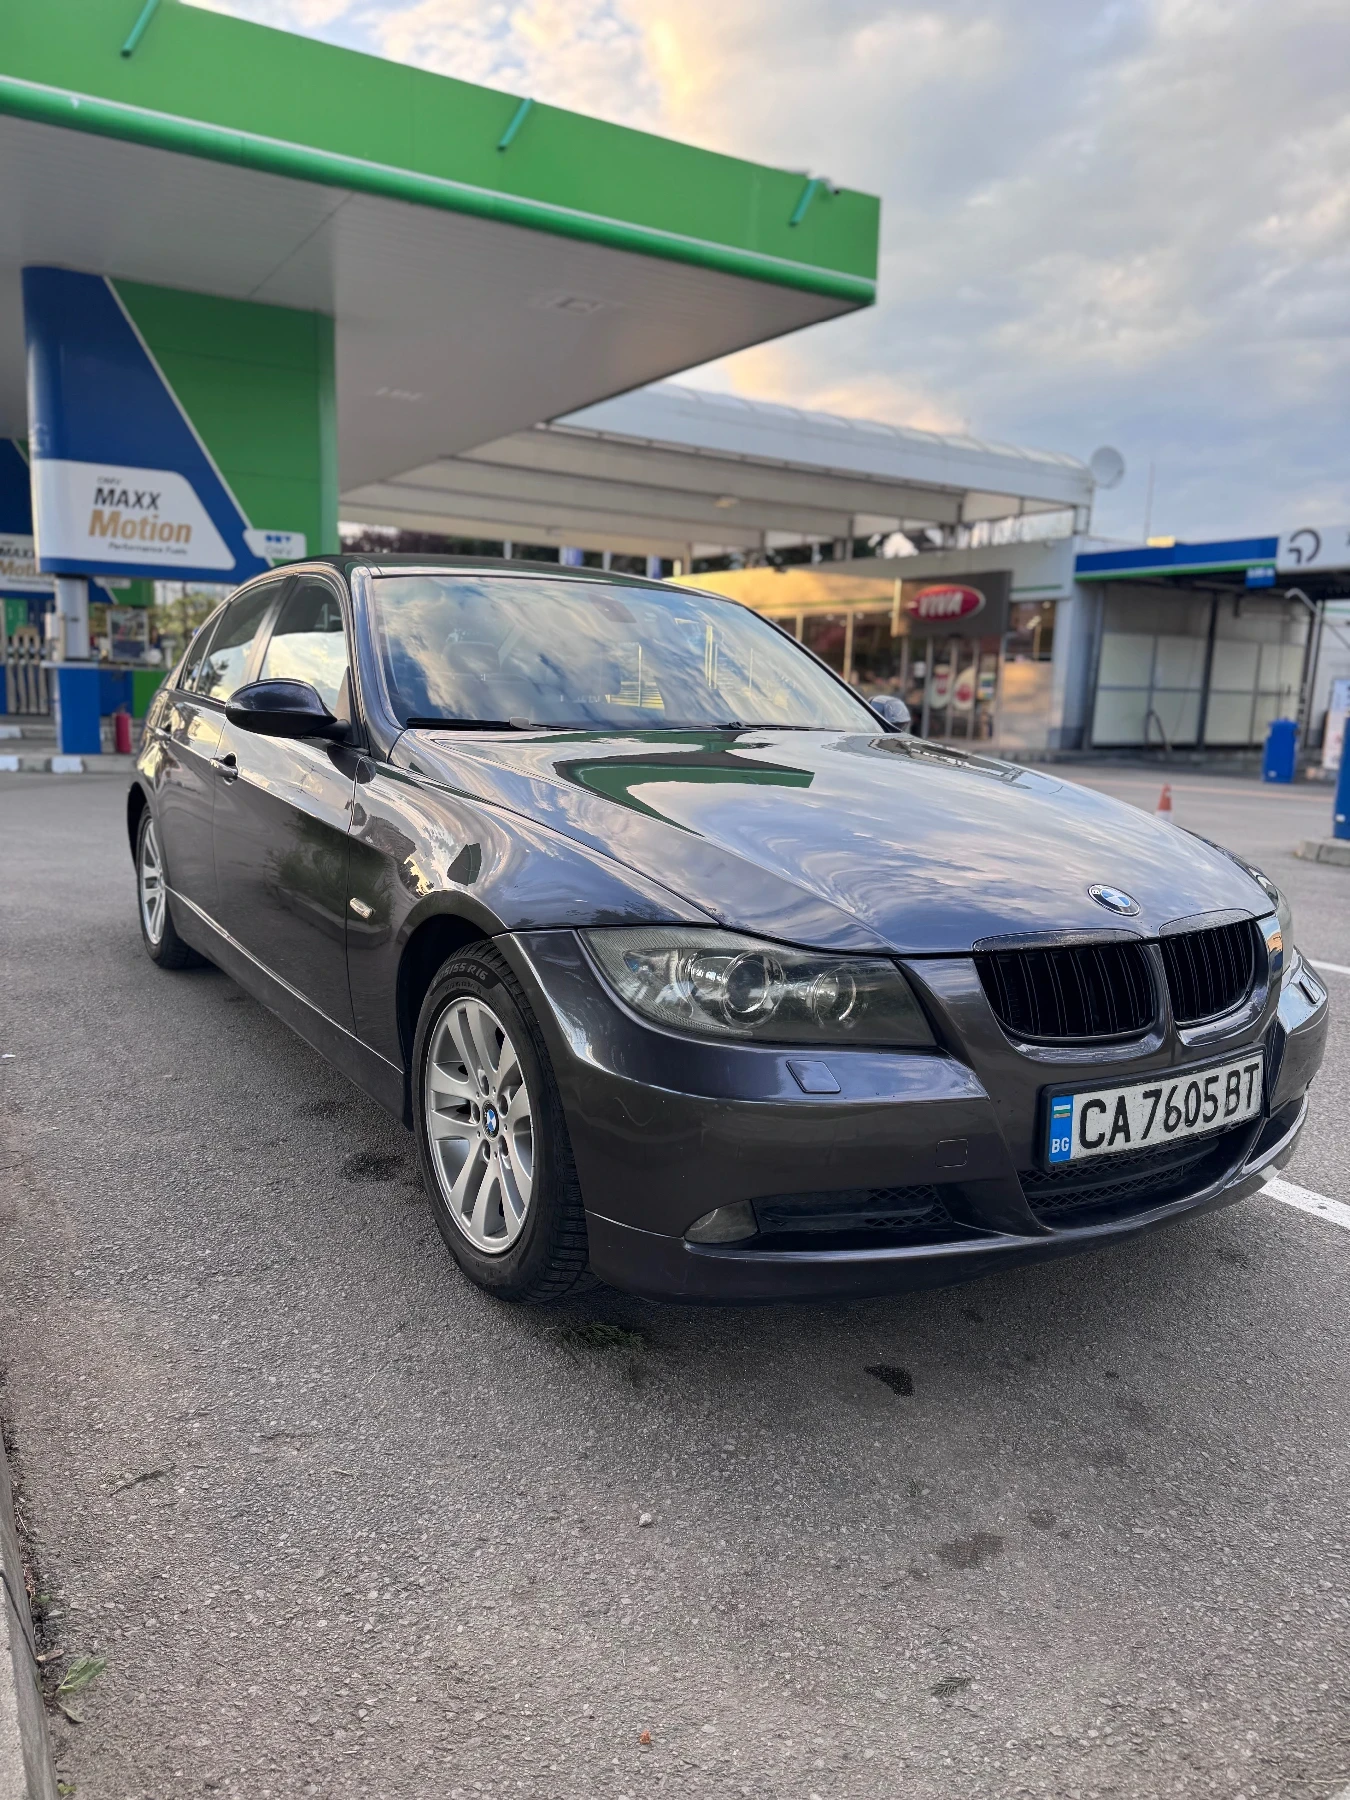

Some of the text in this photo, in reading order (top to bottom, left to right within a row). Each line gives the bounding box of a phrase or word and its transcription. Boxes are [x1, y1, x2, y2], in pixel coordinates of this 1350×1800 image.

[94, 487, 161, 511] MAXX
[88, 509, 193, 544] Motion
[919, 592, 963, 617] VIVA
[1078, 1094, 1131, 1150] CA
[1051, 1137, 1070, 1154] BG
